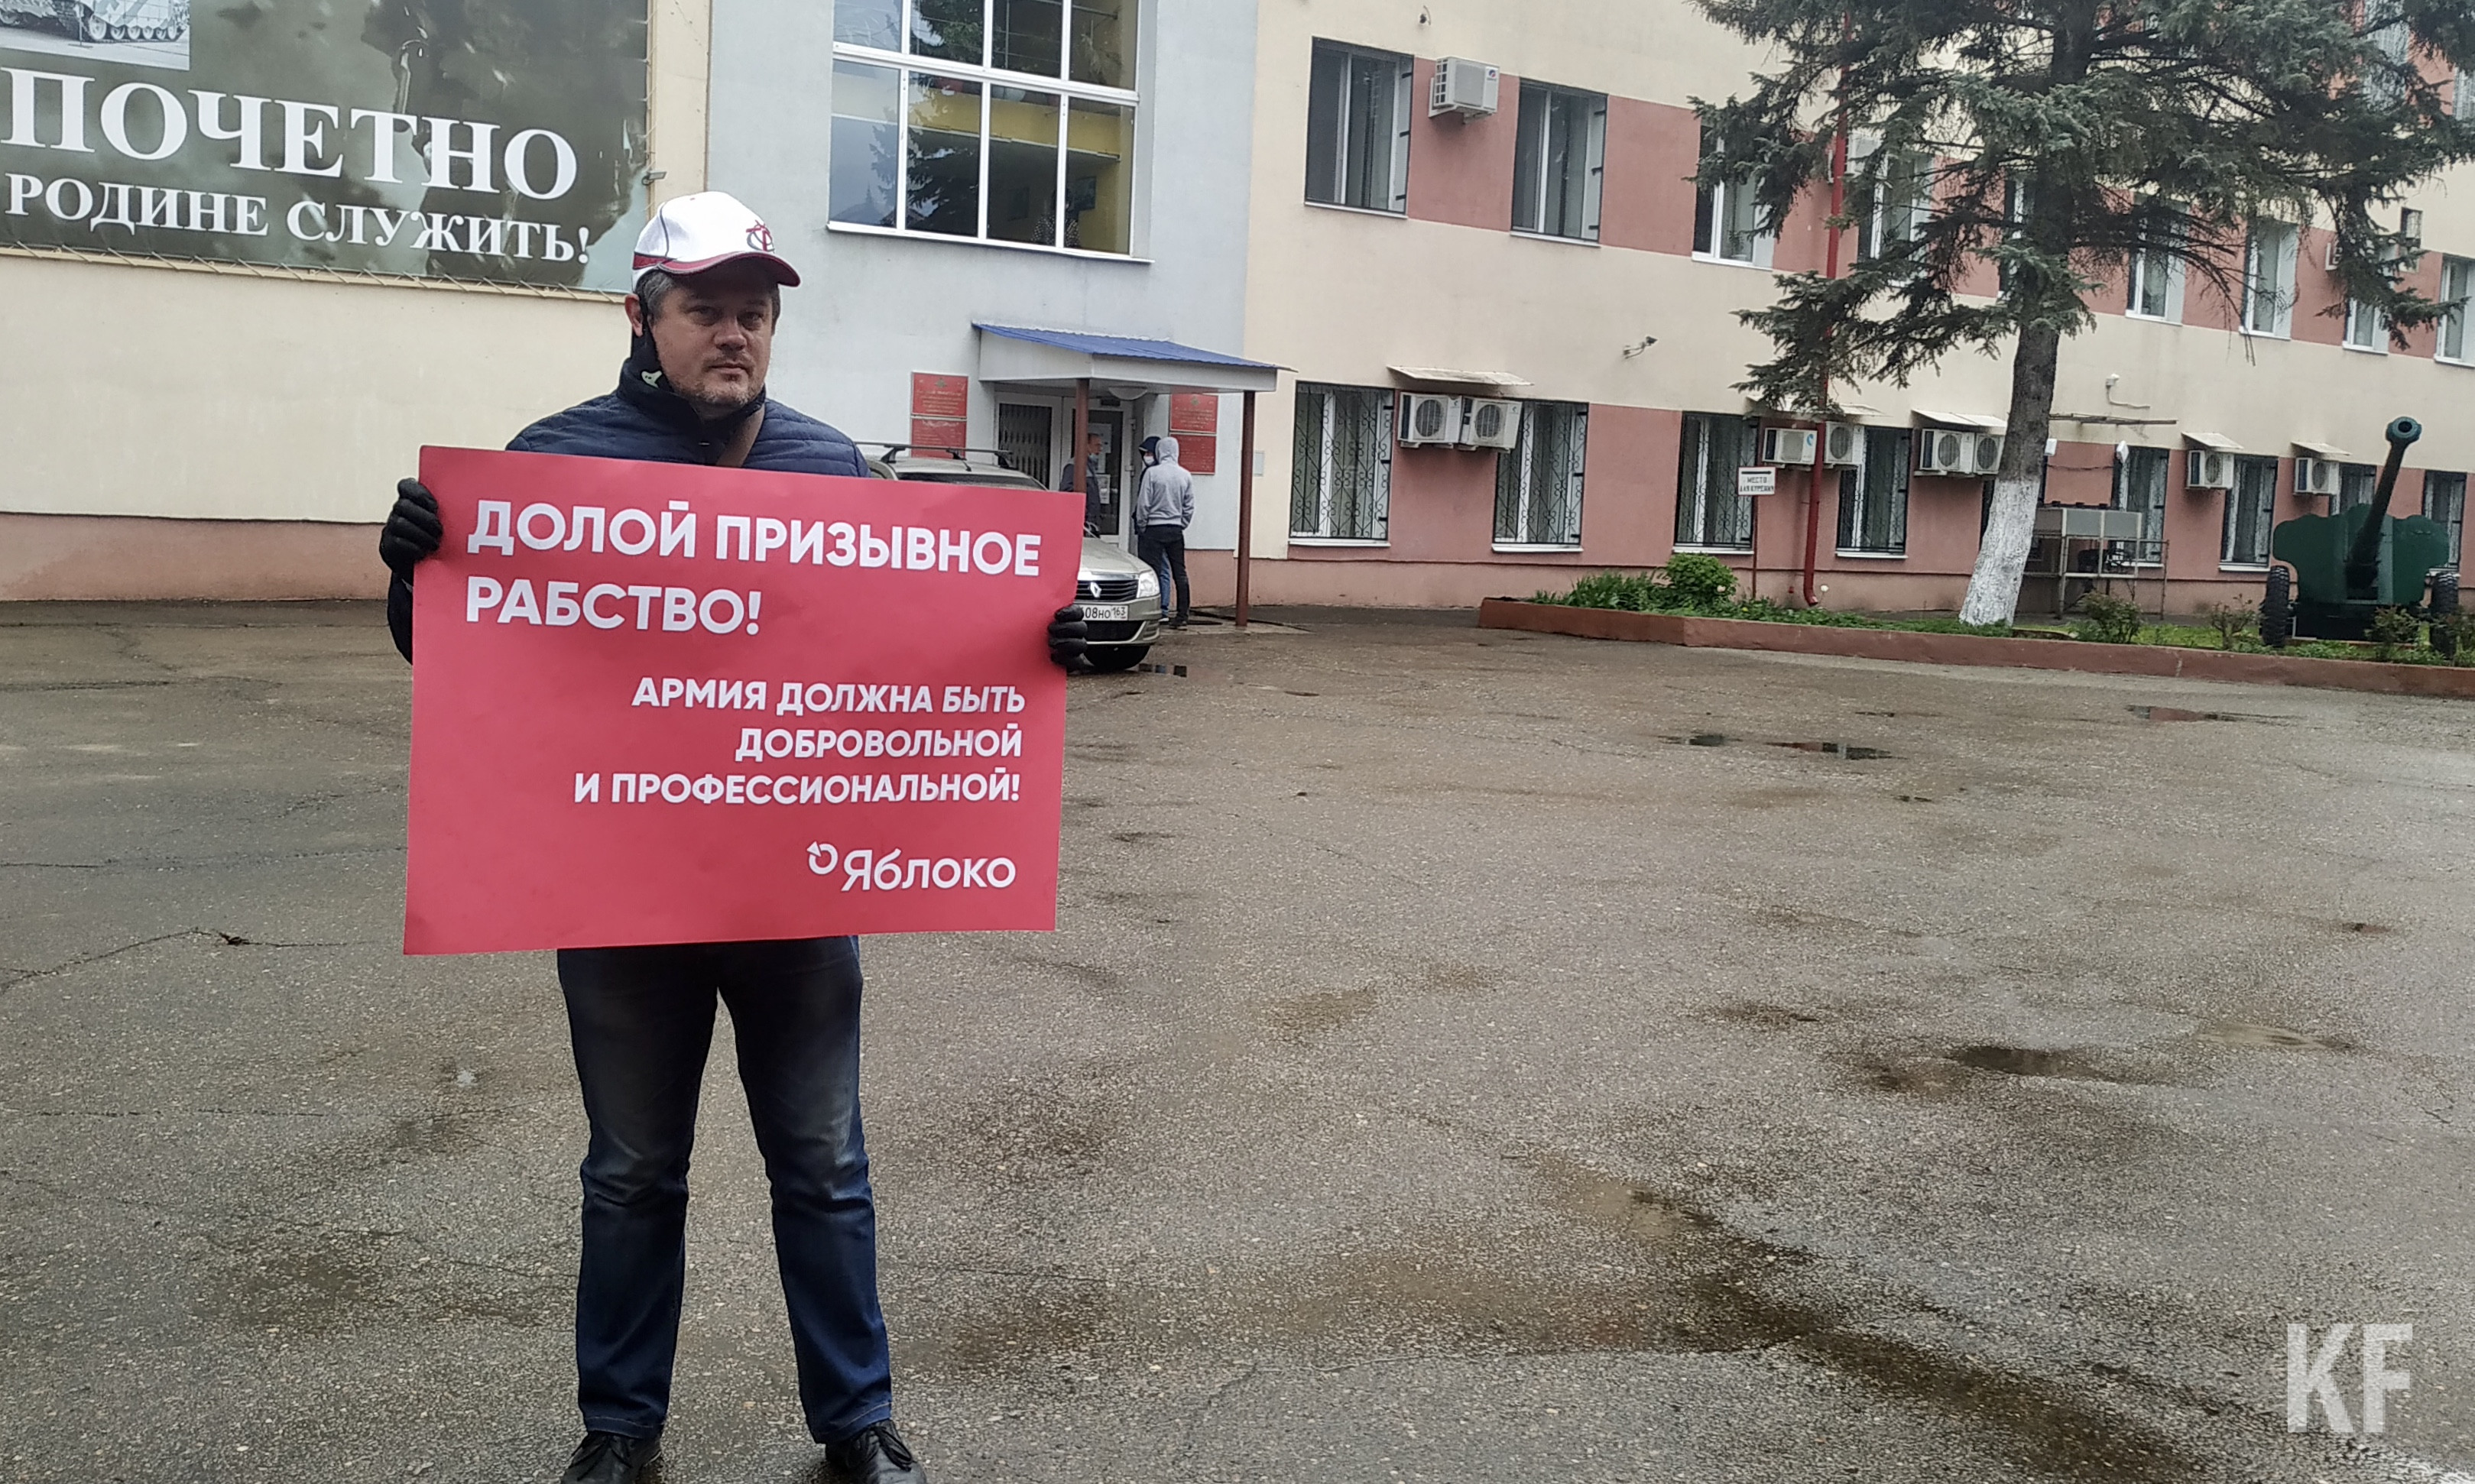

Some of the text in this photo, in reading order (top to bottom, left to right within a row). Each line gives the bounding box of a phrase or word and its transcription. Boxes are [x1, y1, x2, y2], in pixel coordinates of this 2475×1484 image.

[0, 66, 578, 200] ПОЧЕТНО
[5, 173, 590, 264] РОДИНЕ СЛУЖИТЬ!
[466, 500, 1042, 577] ДОЛОЙ ПРИЗЫВНОЕ
[466, 575, 761, 635] РАБСТВО!
[1113, 607, 1126, 616] 163
[631, 677, 1026, 717] АРМИЯ ДОЛЖНА БЫТЬ
[735, 722, 1023, 763] ДОБРОВОЛЬНОЙ
[574, 766, 1021, 805] И ПРОФЕССИОНАЛЬНОЙ!
[840, 847, 1017, 892] Яблоко
